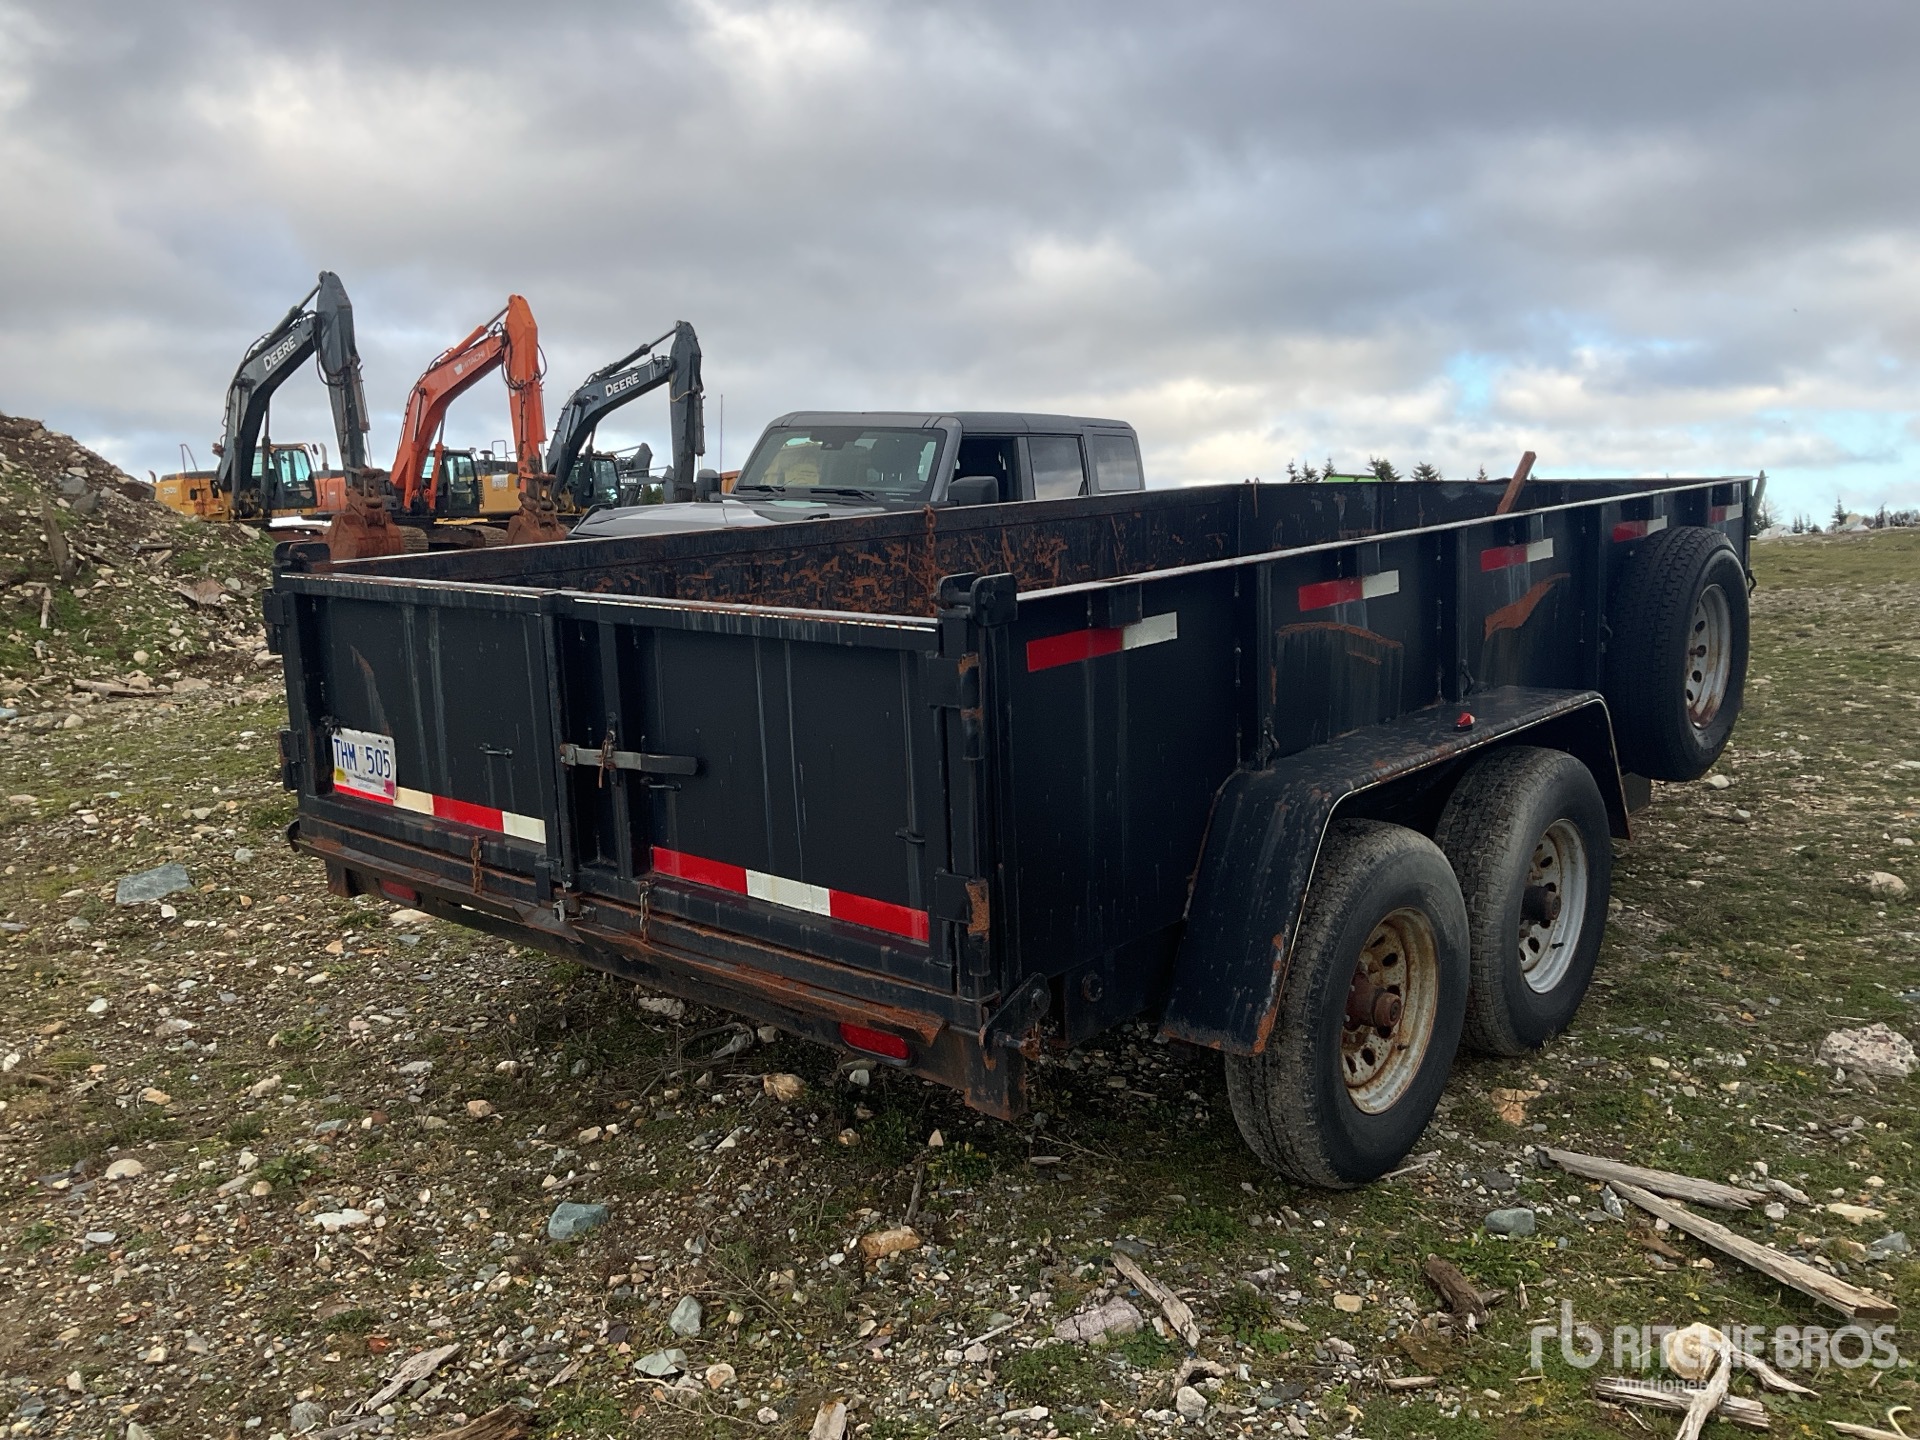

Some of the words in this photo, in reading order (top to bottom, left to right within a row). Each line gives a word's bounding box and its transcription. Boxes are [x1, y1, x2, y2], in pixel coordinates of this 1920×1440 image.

[263, 335, 296, 371] DEERE
[462, 350, 486, 369] HITACHI
[605, 372, 639, 397] DEERE
[333, 738, 358, 771] THM
[365, 746, 391, 779] 505
